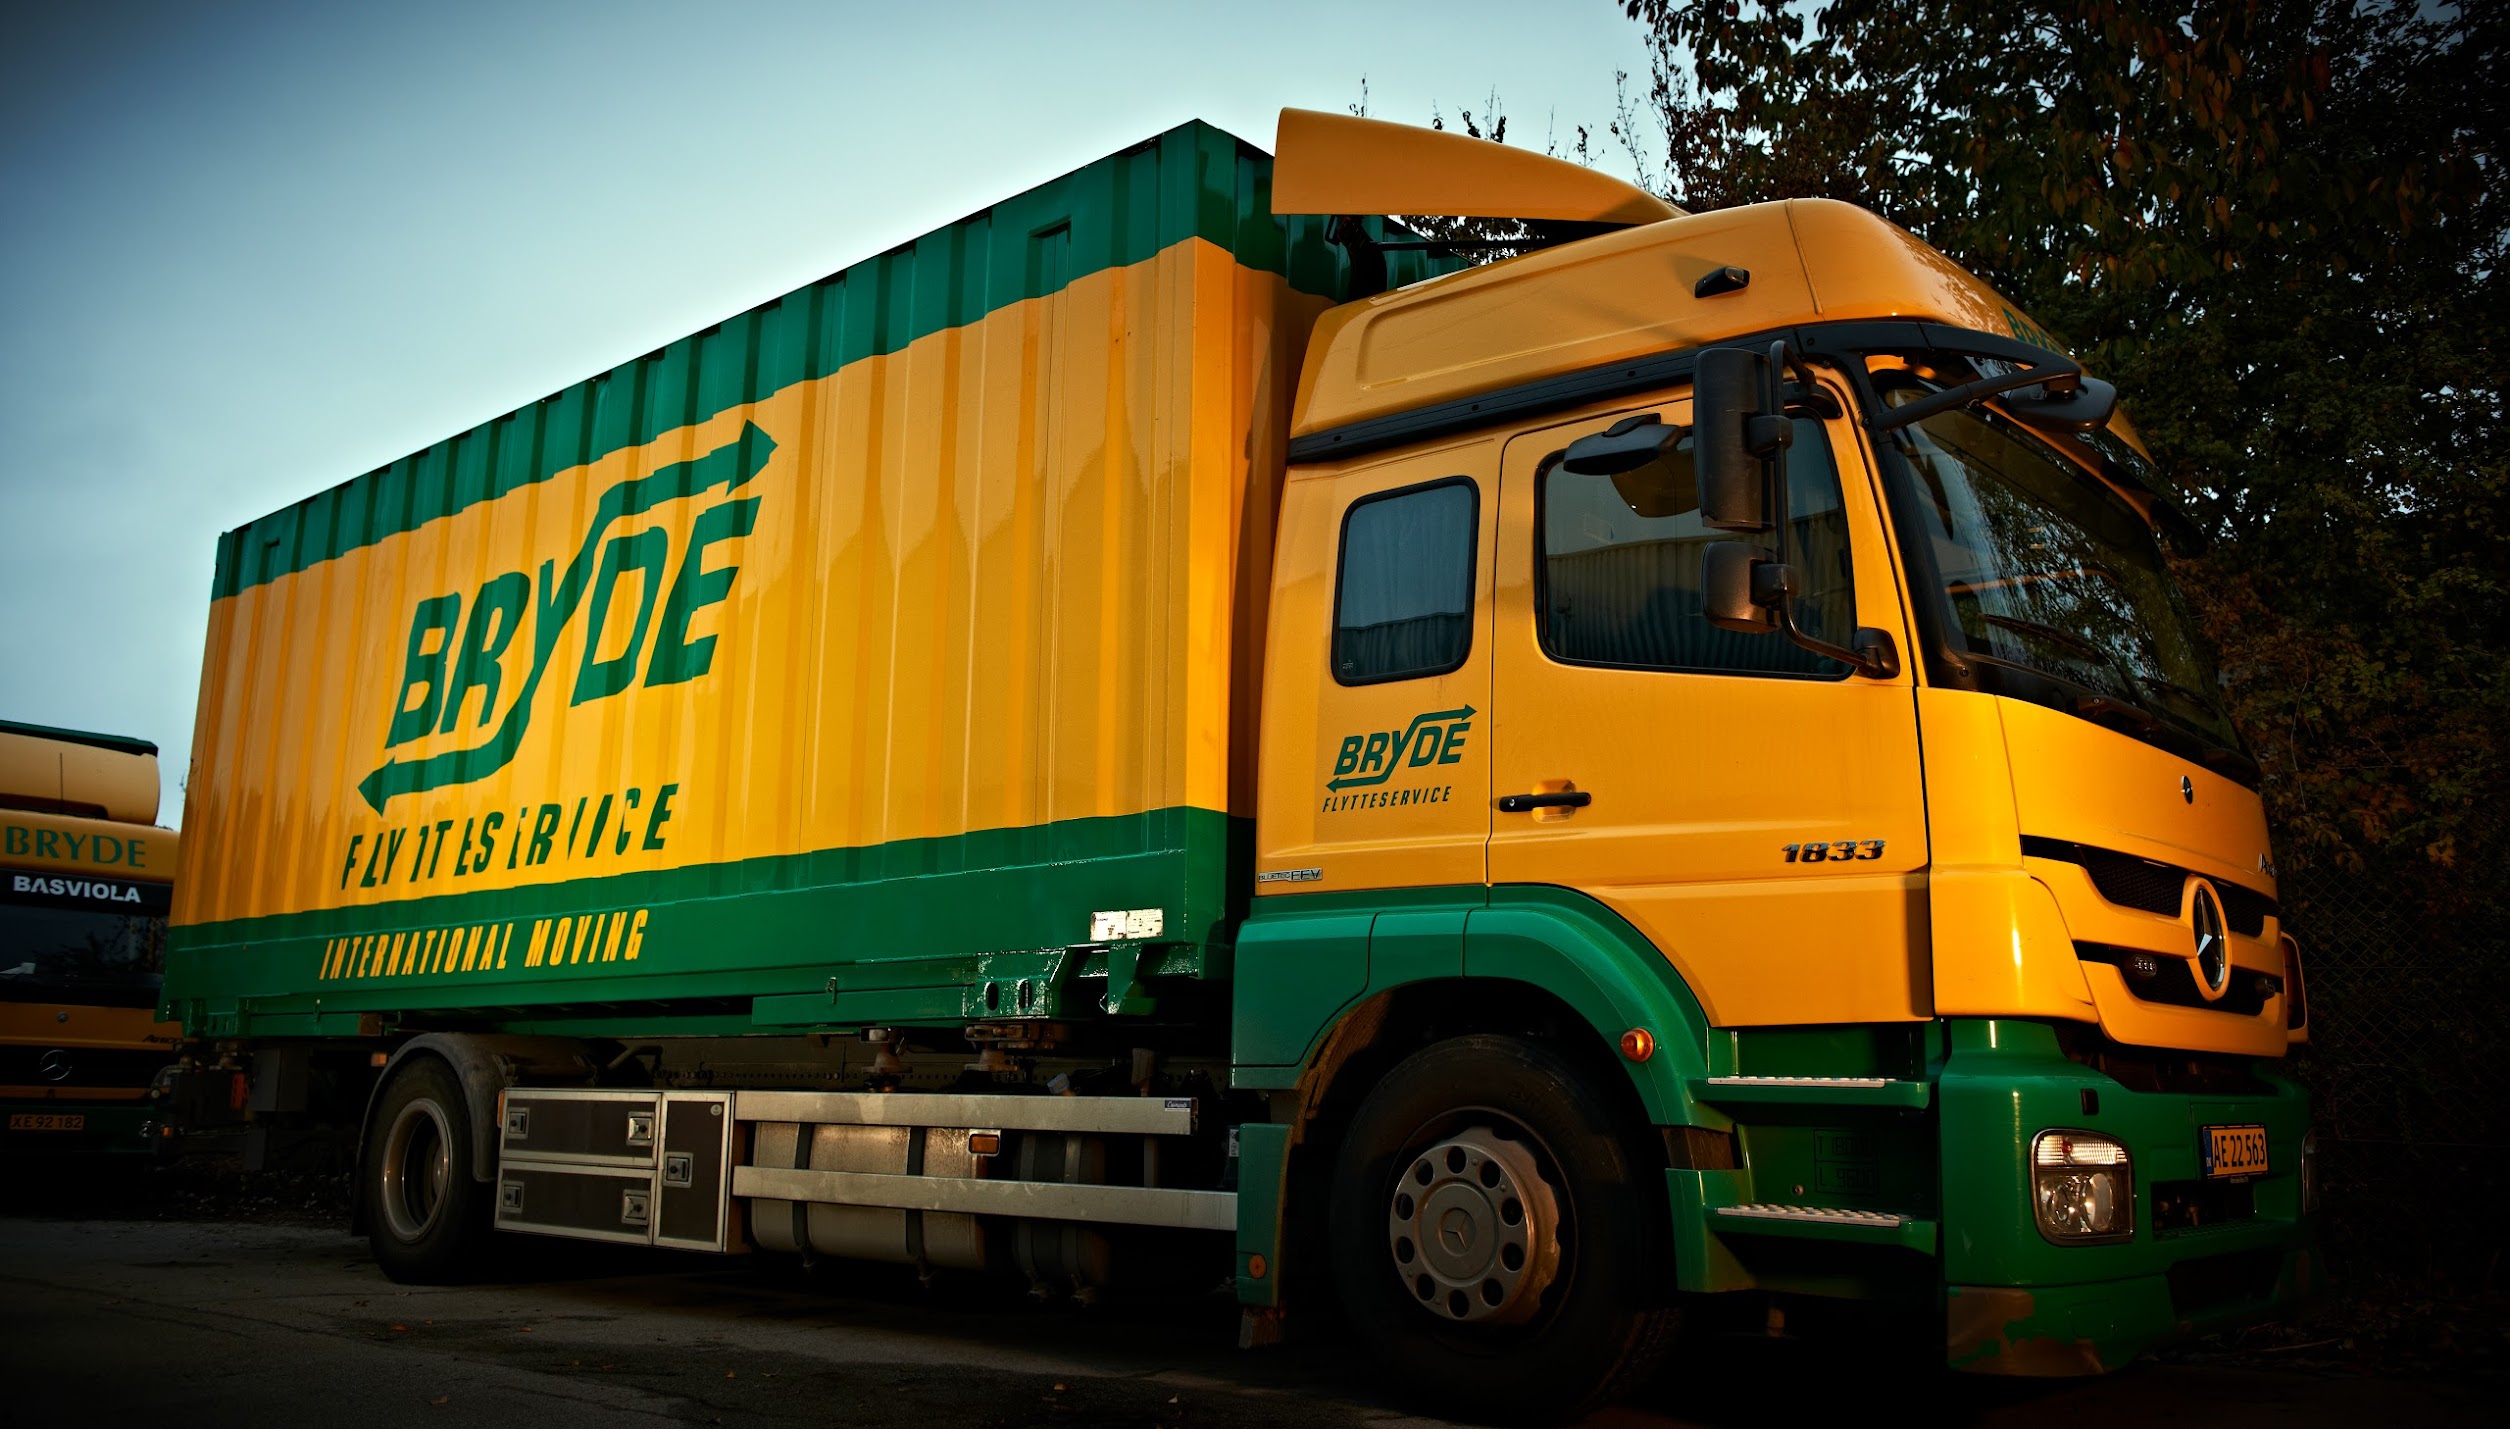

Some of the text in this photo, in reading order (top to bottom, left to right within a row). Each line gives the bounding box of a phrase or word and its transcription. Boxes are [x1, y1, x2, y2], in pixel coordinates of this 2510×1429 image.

[380, 482, 766, 772] BRYDE
[1332, 718, 1472, 781] BRYDE
[1322, 786, 1451, 813] FLYTTESERVICE
[6, 826, 146, 867] BRYDE
[1781, 839, 1886, 863] 1833
[13, 875, 142, 904] BASVIOLA
[319, 909, 648, 981] INTERNATIONAL MOVING
[36, 1116, 54, 1128] 92
[58, 1116, 82, 1129] 182
[2214, 1133, 2265, 1168] AE 22 563
